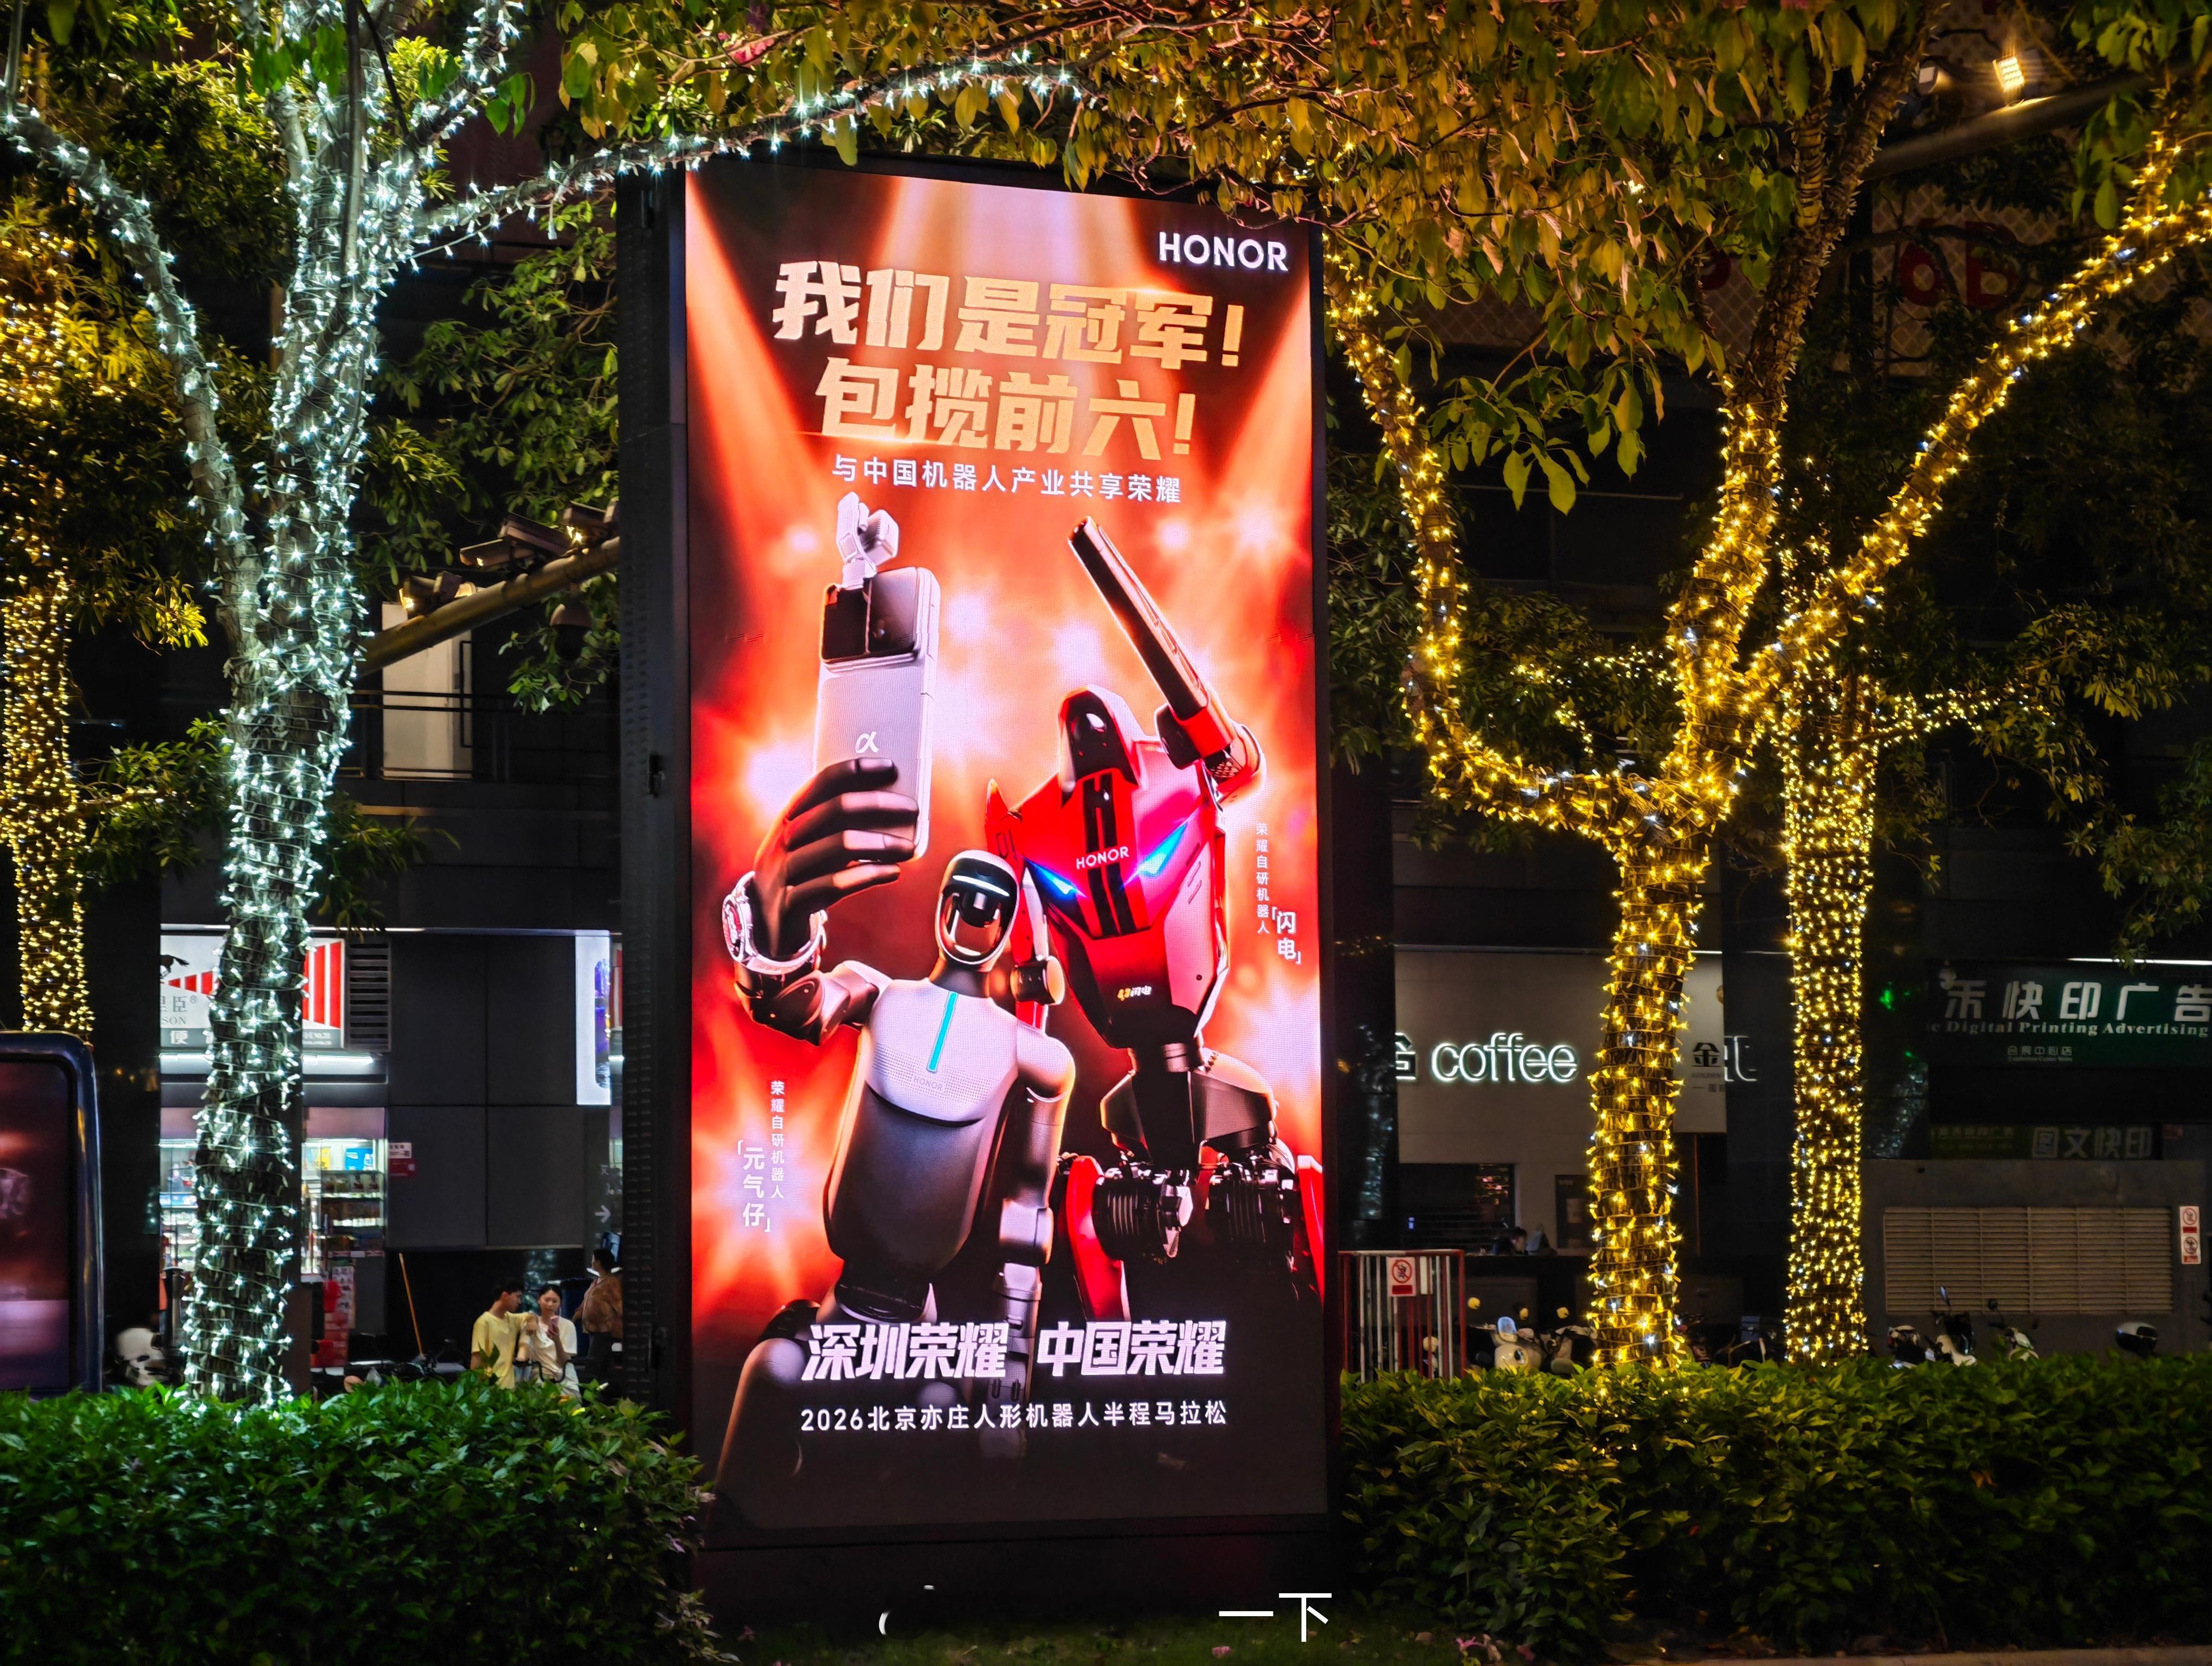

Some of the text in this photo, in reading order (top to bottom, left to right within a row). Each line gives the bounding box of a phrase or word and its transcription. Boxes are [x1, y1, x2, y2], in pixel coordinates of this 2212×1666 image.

[1159, 232, 1289, 272] HONOR
[773, 260, 1244, 369] 我们是冠军！
[814, 356, 1197, 460] 包揽前六！
[832, 454, 1181, 504] 与中国机器人产业共享荣耀
[1076, 845, 1130, 870] HONOR
[1255, 822, 1270, 934] 荣耀自研机器人
[1947, 1021, 2012, 1035] Digital
[2019, 1021, 2099, 1036] Printing
[2102, 1022, 2209, 1038] Advertising
[1431, 1033, 1579, 1083] coffee
[770, 1080, 785, 1199] 荣耀自研机器人
[801, 1319, 1227, 1381] 深圳荣耀 中国荣耀
[800, 1400, 1227, 1431] 2026北京亦庄人形机器人半程马拉松
